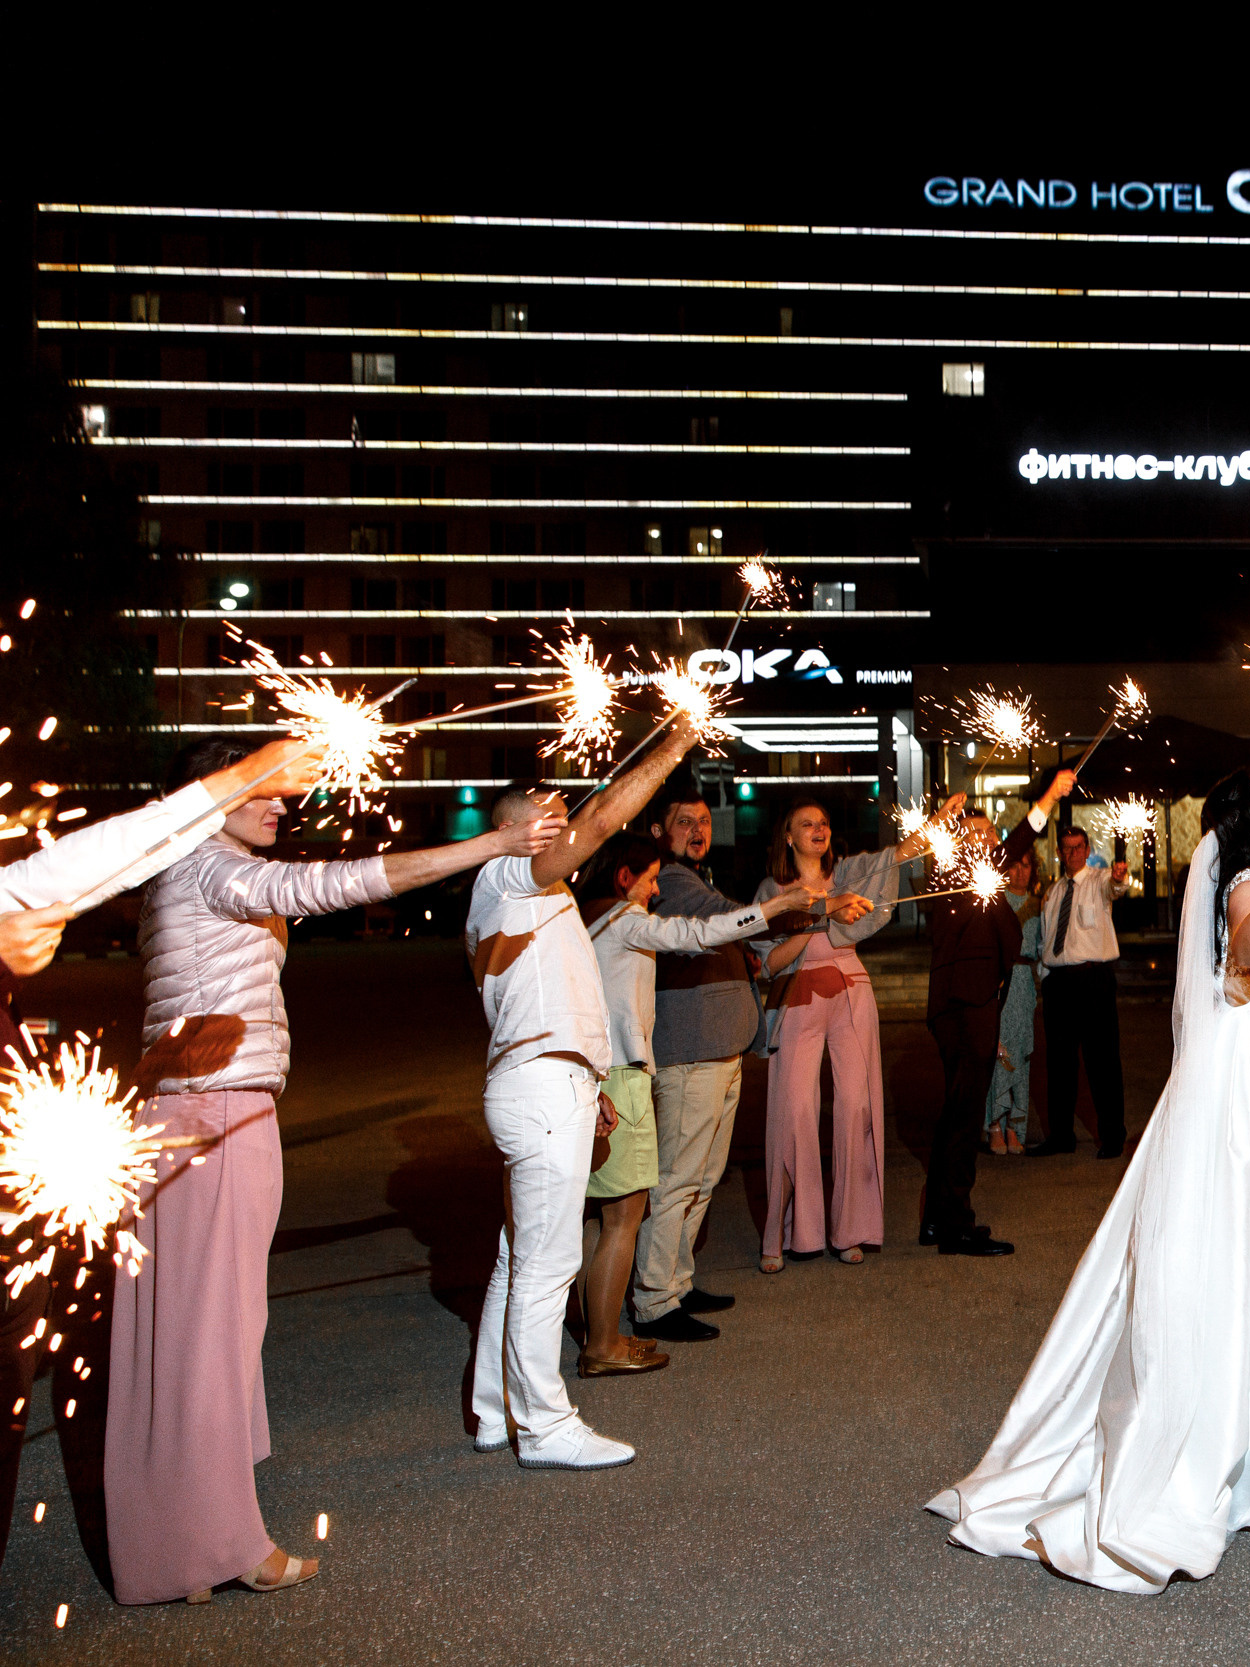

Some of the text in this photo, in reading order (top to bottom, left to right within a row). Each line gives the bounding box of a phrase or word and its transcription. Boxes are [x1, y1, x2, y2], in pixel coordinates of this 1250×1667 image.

[924, 176, 1077, 208] GRAND
[1092, 181, 1214, 213] HOTEL
[687, 648, 843, 685] OKA
[856, 670, 913, 684] PREMIUM
